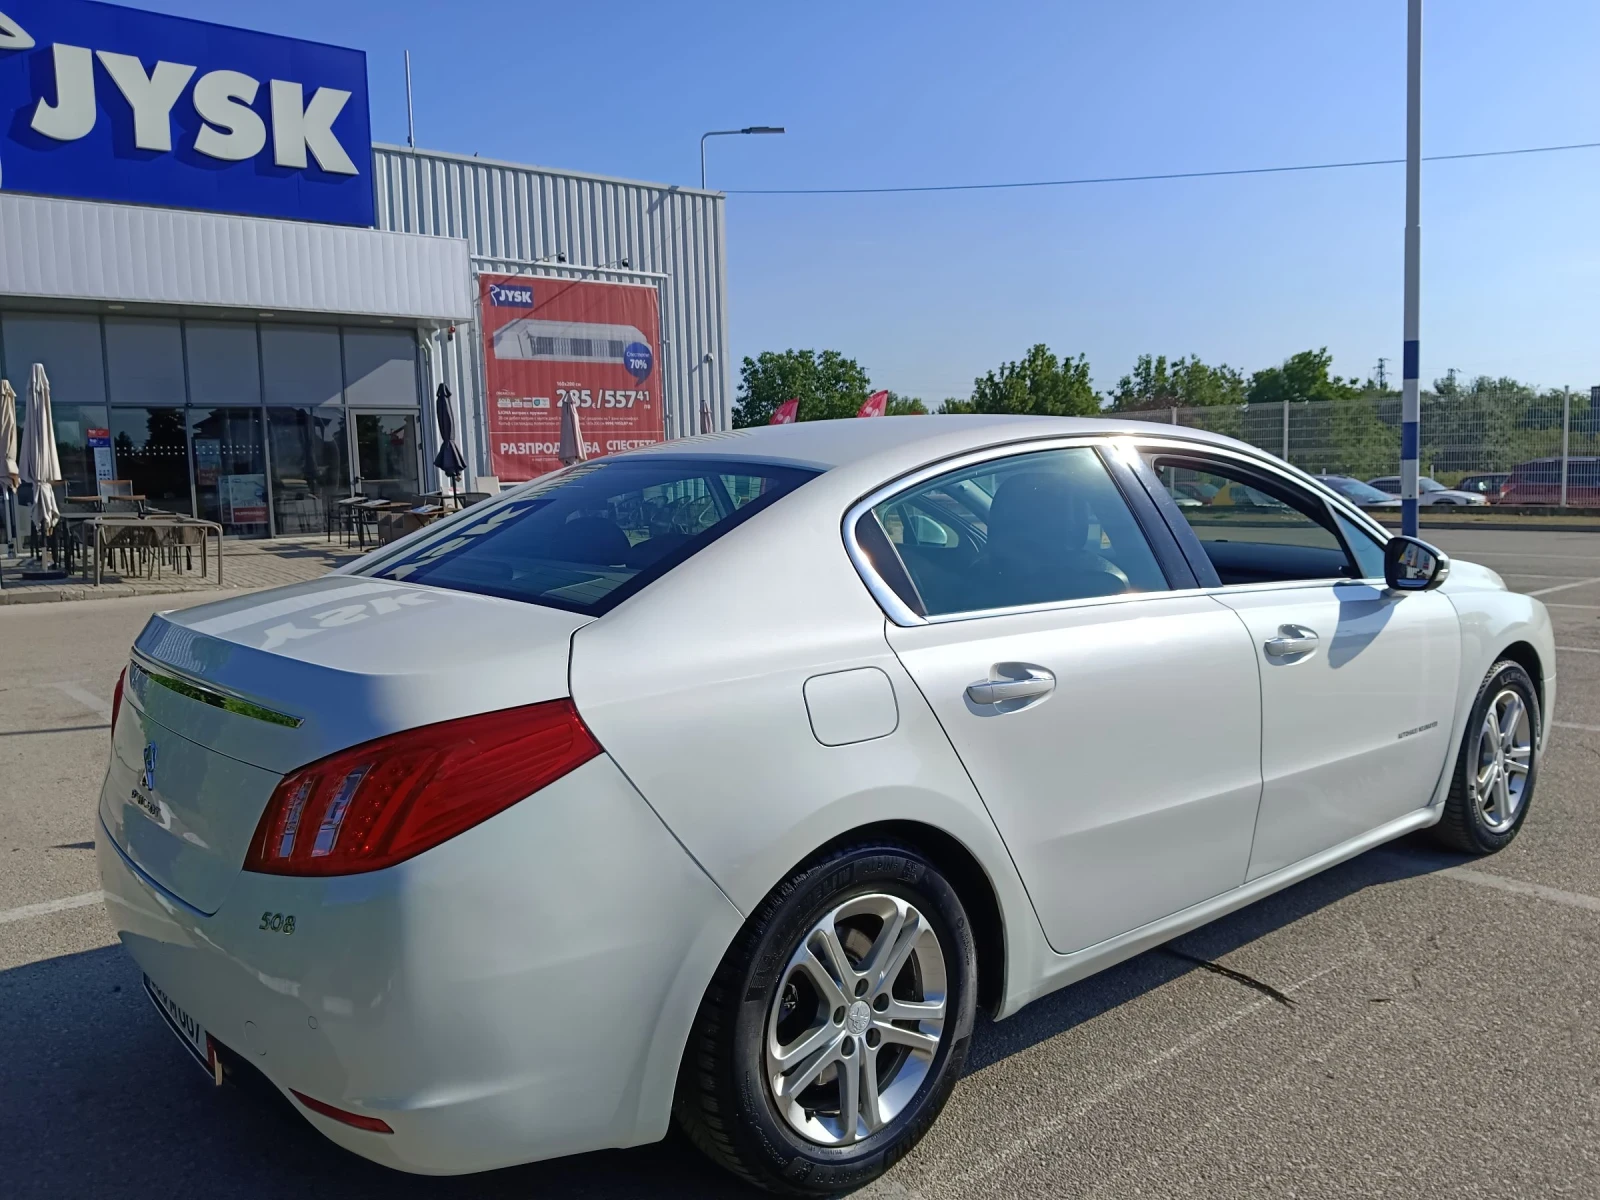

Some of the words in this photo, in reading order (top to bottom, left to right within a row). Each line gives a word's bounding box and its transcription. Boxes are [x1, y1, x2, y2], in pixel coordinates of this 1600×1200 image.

[31, 42, 360, 175] JYSK
[499, 290, 532, 303] JYSK
[630, 359, 648, 369] 70%
[500, 441, 600, 455] РАЗПРОДБА
[259, 911, 296, 936] 508
